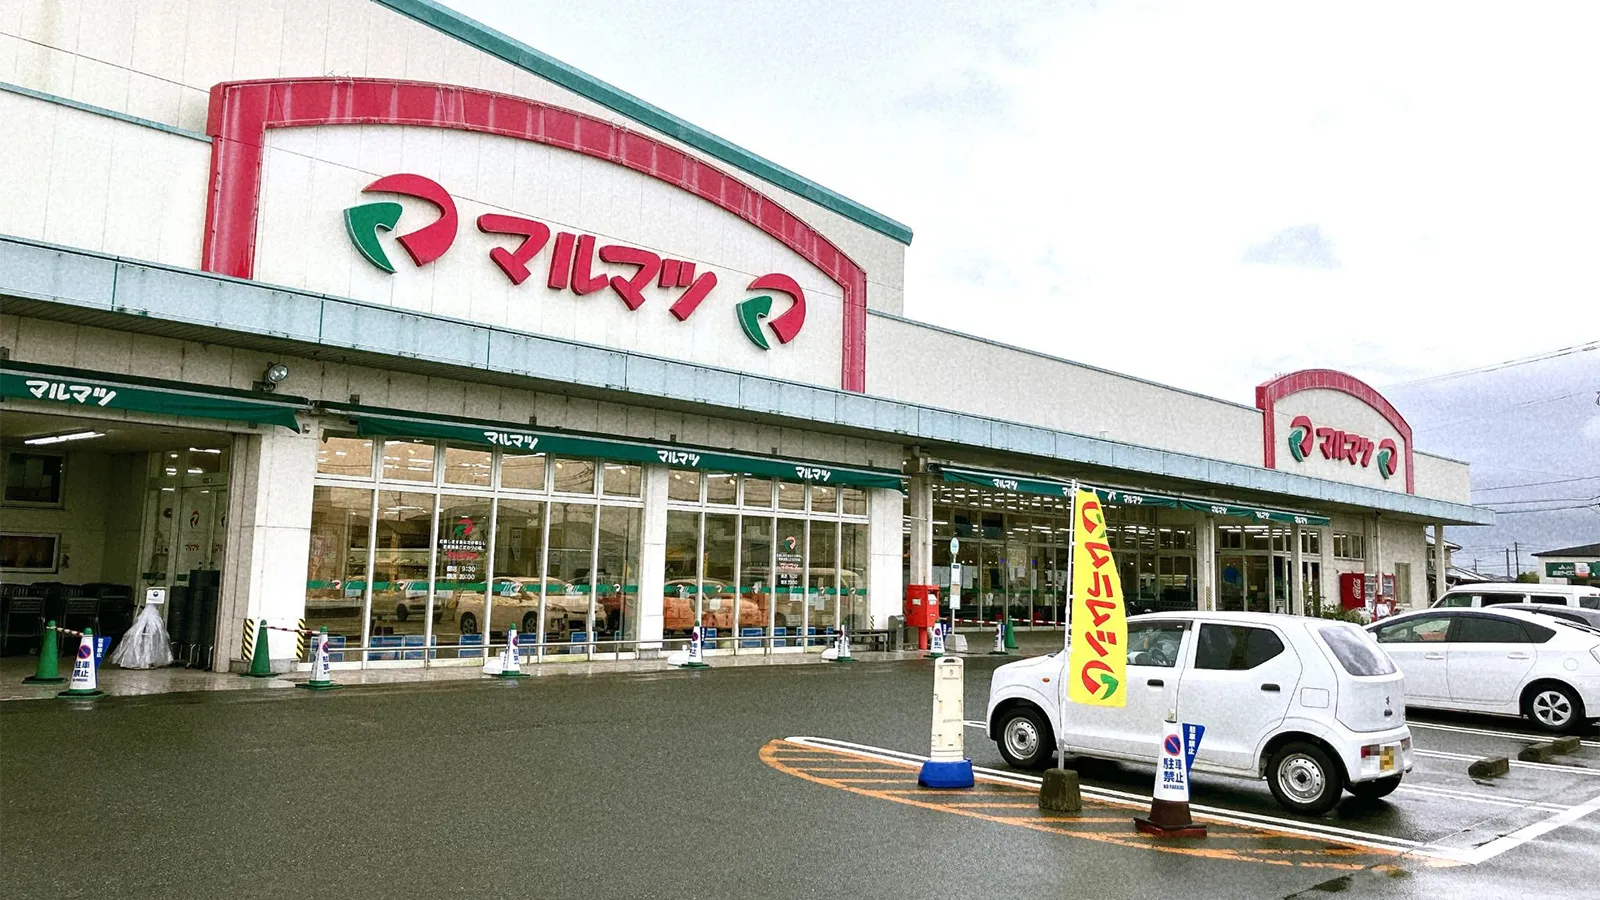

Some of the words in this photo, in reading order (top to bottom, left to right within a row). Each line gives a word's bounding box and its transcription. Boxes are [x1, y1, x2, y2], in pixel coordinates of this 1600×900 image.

[477, 213, 718, 322] マルマツ
[25, 380, 117, 407] マルマツ
[483, 431, 539, 450] マルマツ
[1316, 427, 1374, 468] マルマツ
[656, 450, 700, 467] マルマツ
[795, 466, 831, 481] マルマツ
[992, 478, 1018, 490] マルマツ
[1188, 726, 1196, 755] 駐車禁止
[1163, 757, 1183, 770] 駐車
[1163, 771, 1184, 784] 禁止
